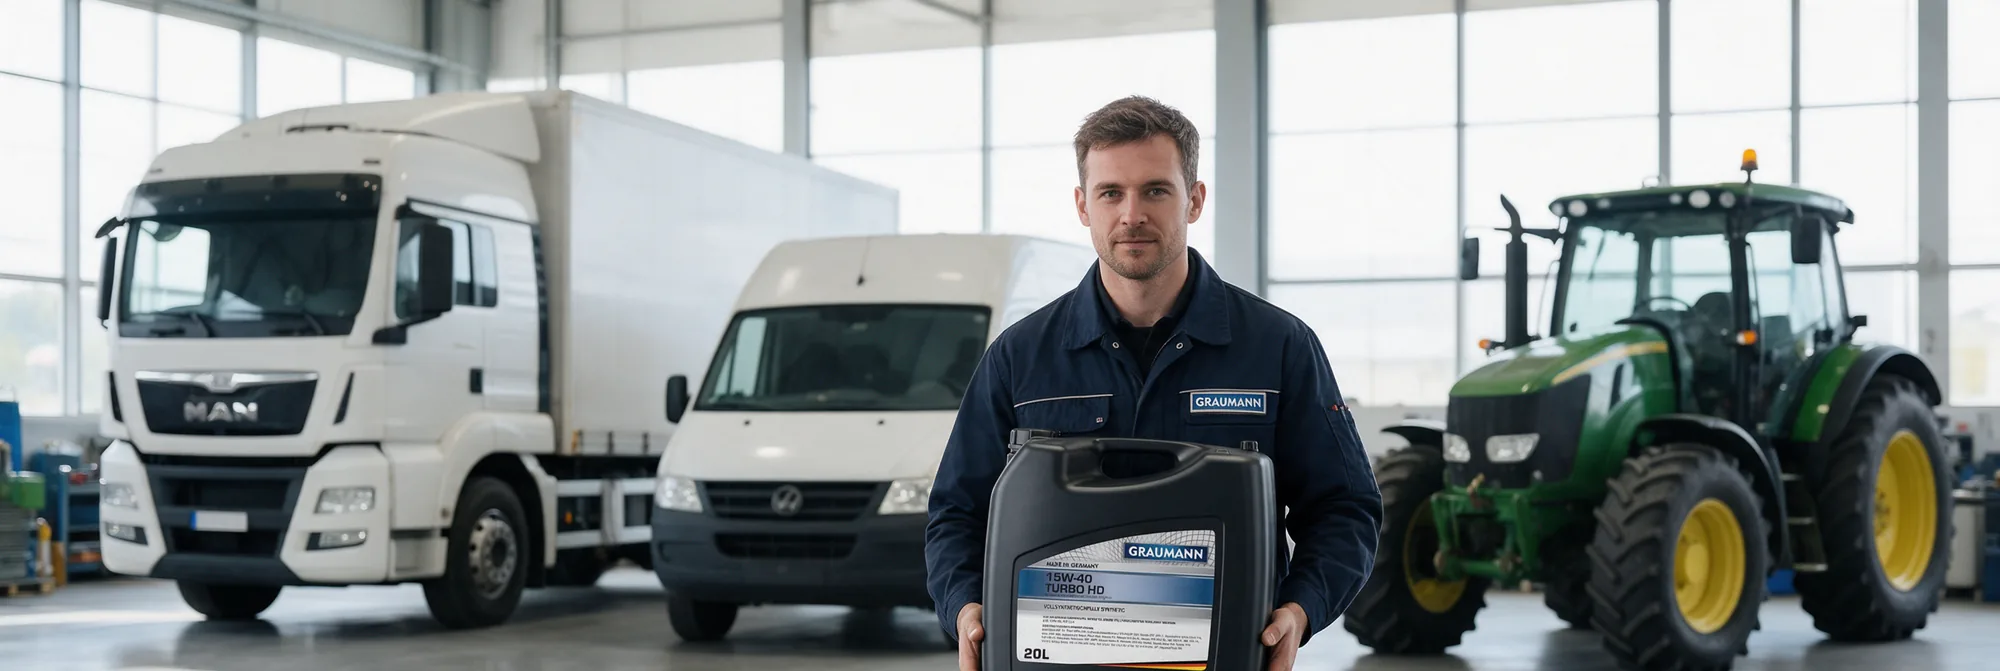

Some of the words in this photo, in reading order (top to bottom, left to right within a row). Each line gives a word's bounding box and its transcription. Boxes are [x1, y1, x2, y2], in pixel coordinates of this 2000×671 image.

[1195, 397, 1261, 407] GRAUMANN
[183, 401, 258, 422] MAN
[1128, 546, 1203, 560] GRAUMANN
[1046, 572, 1093, 584] 15W-40
[1045, 583, 1085, 594] TURBO
[1087, 585, 1105, 595] HD
[1024, 648, 1049, 660] 20L
